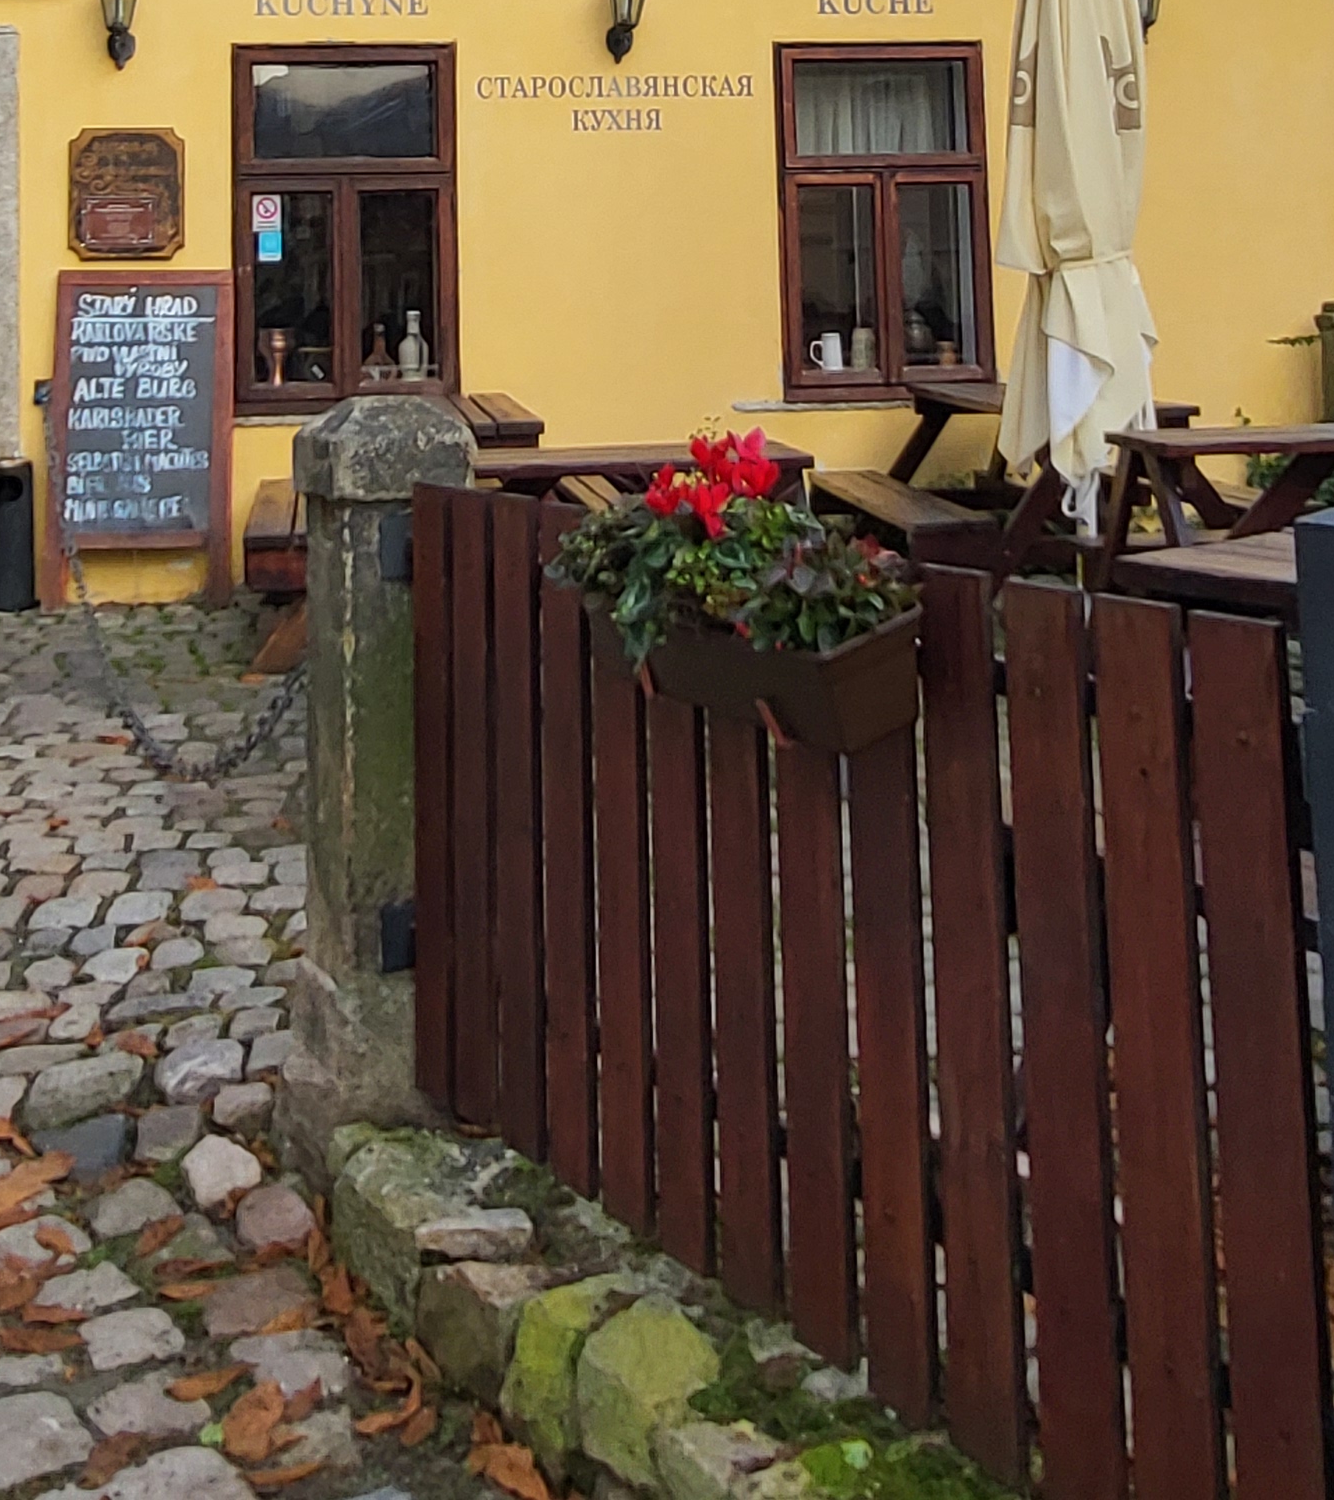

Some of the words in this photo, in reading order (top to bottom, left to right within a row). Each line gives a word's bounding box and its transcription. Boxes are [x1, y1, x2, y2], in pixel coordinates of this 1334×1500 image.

[475, 74, 755, 101] СТАРОСЛАВЯНСКАЯ
[571, 108, 663, 133] КУХНЯ
[73, 377, 126, 404] ALTE
[136, 377, 197, 399] BURG
